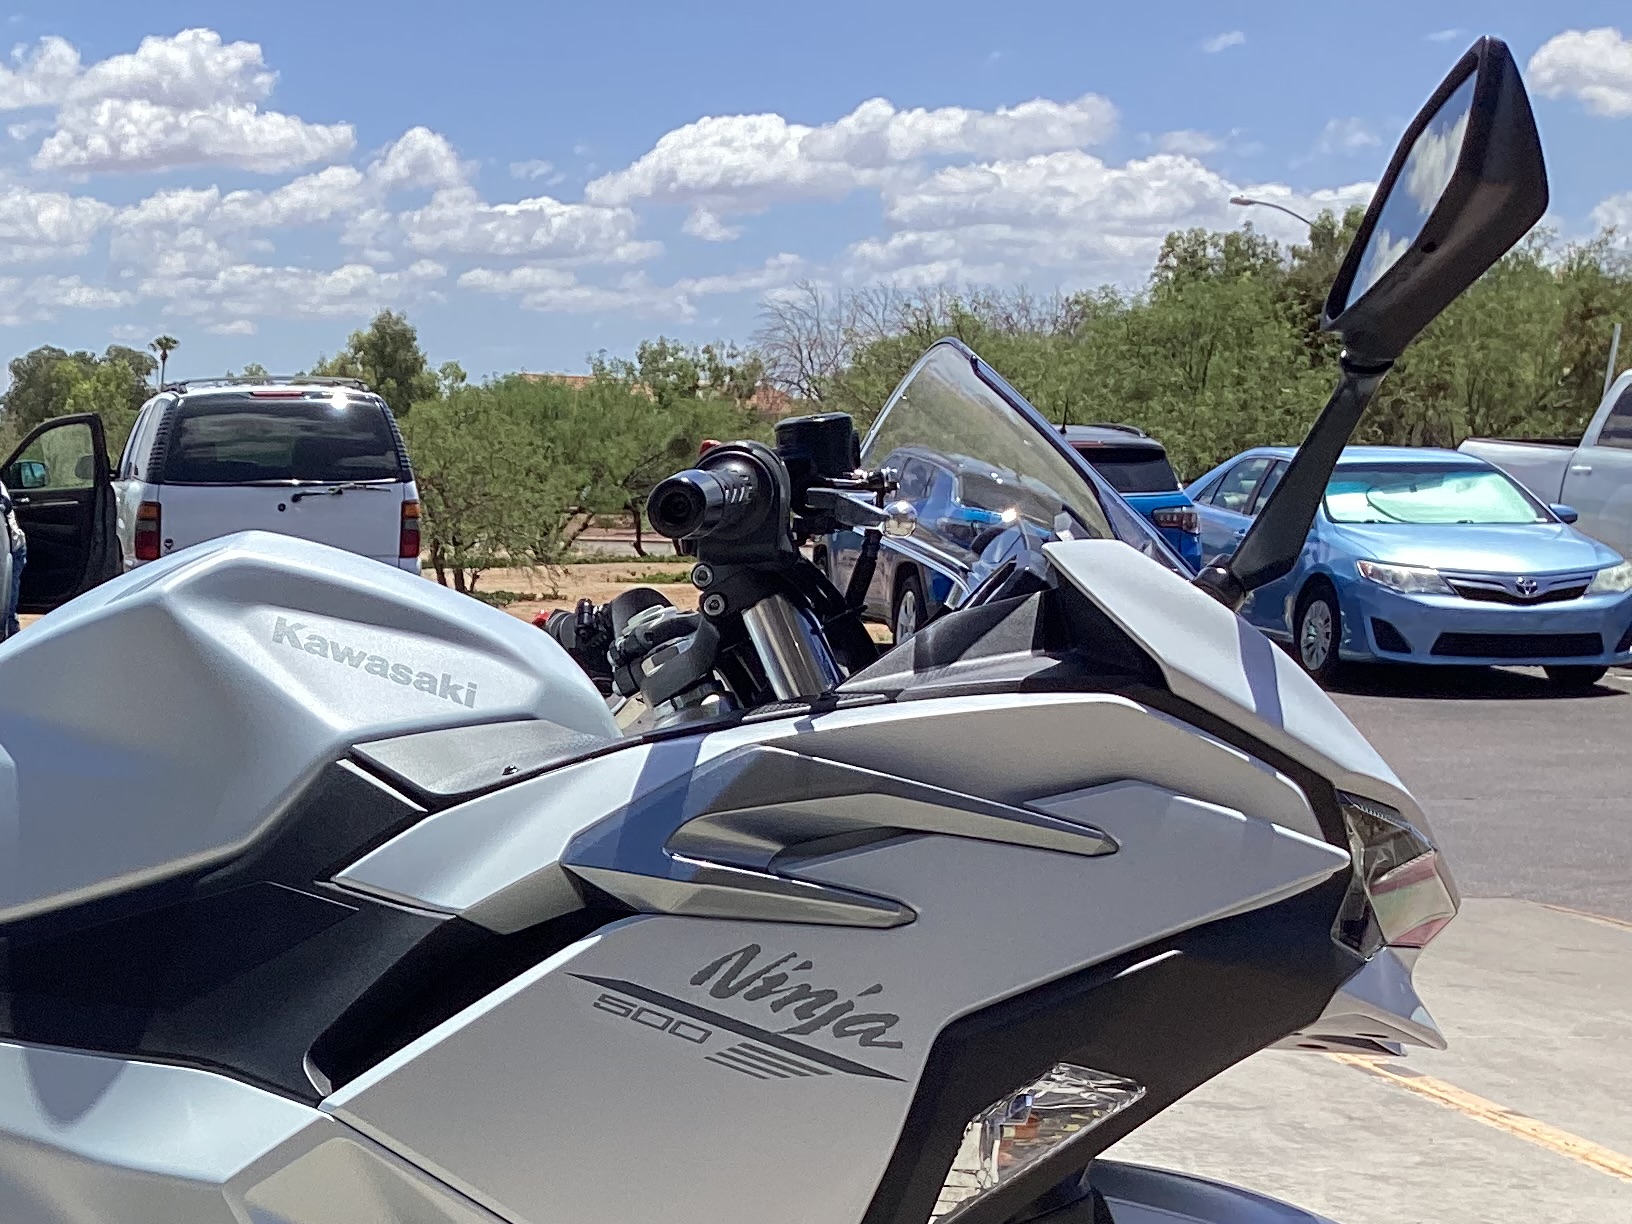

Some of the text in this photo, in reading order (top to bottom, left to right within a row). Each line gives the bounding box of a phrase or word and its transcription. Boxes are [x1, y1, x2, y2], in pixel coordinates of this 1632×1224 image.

[271, 615, 479, 709] Kawasaki
[592, 992, 713, 1045] 500
[689, 942, 904, 1050] Ninja
